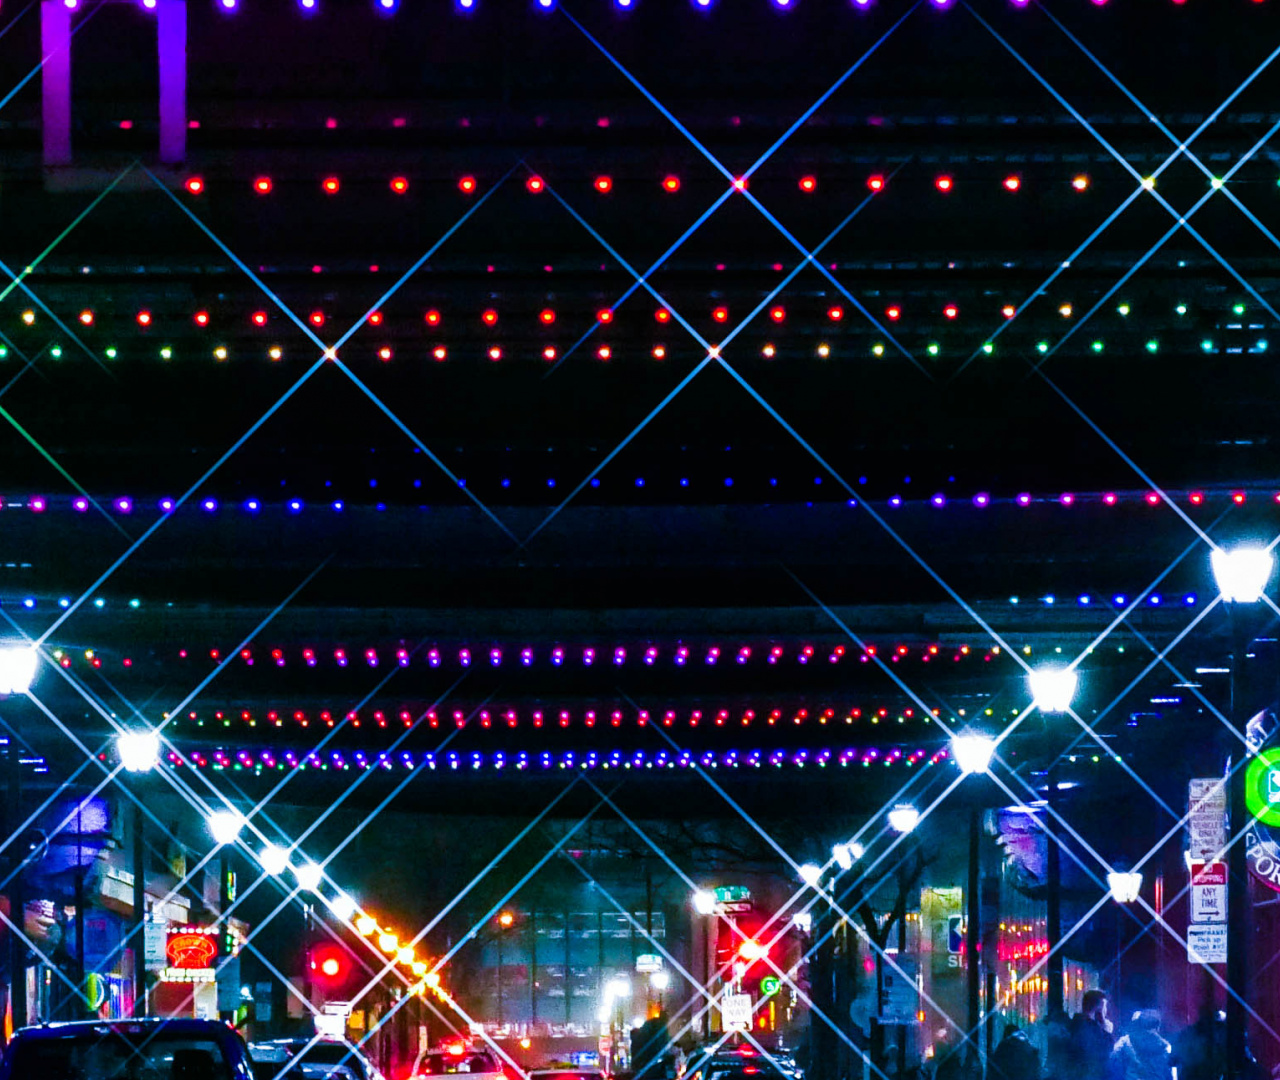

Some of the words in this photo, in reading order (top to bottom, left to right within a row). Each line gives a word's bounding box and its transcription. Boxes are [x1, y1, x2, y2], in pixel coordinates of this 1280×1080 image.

[1201, 887, 1217, 898] ANY
[1201, 899, 1219, 909] TIME
[726, 998, 747, 1008] ONE
